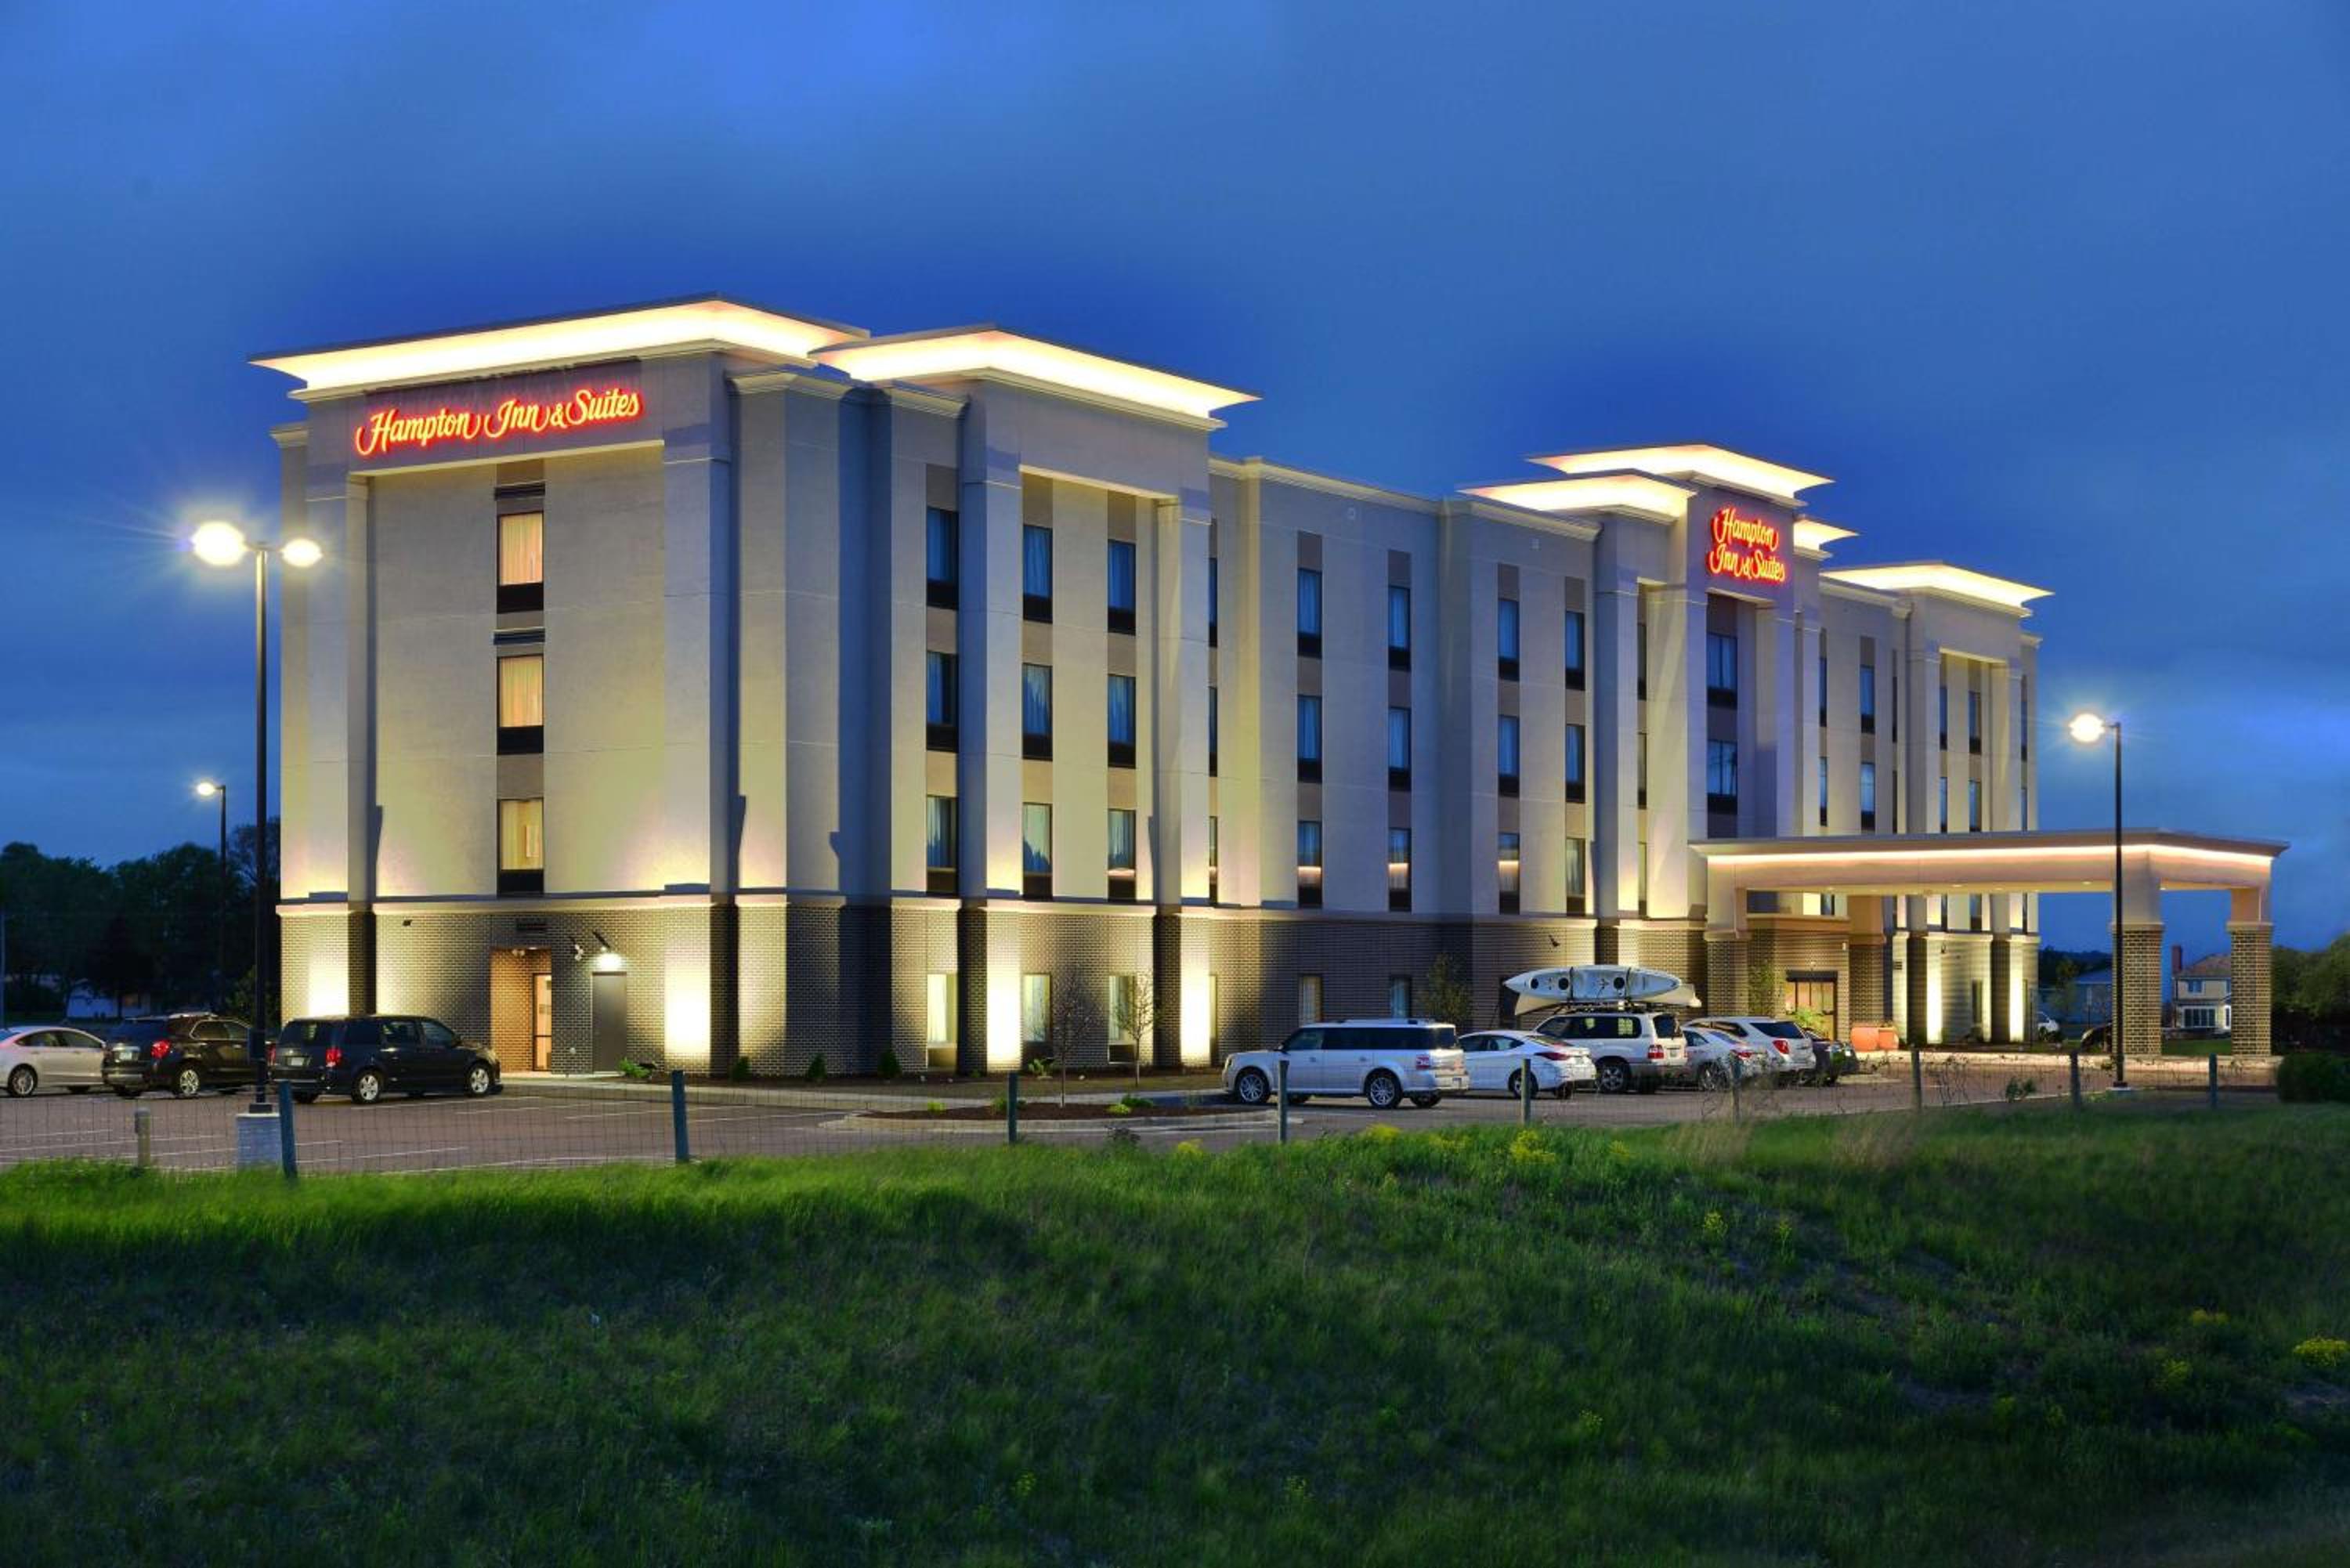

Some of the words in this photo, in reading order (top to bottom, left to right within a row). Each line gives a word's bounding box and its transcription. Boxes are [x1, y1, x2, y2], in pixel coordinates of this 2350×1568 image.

[356, 408, 481, 456] Hampton
[483, 399, 551, 439] Inn
[550, 403, 568, 429] &
[566, 388, 641, 425] Suites
[1713, 508, 1779, 551] Hampton
[1709, 543, 1743, 576] Inn
[1750, 549, 1785, 582] Suites
